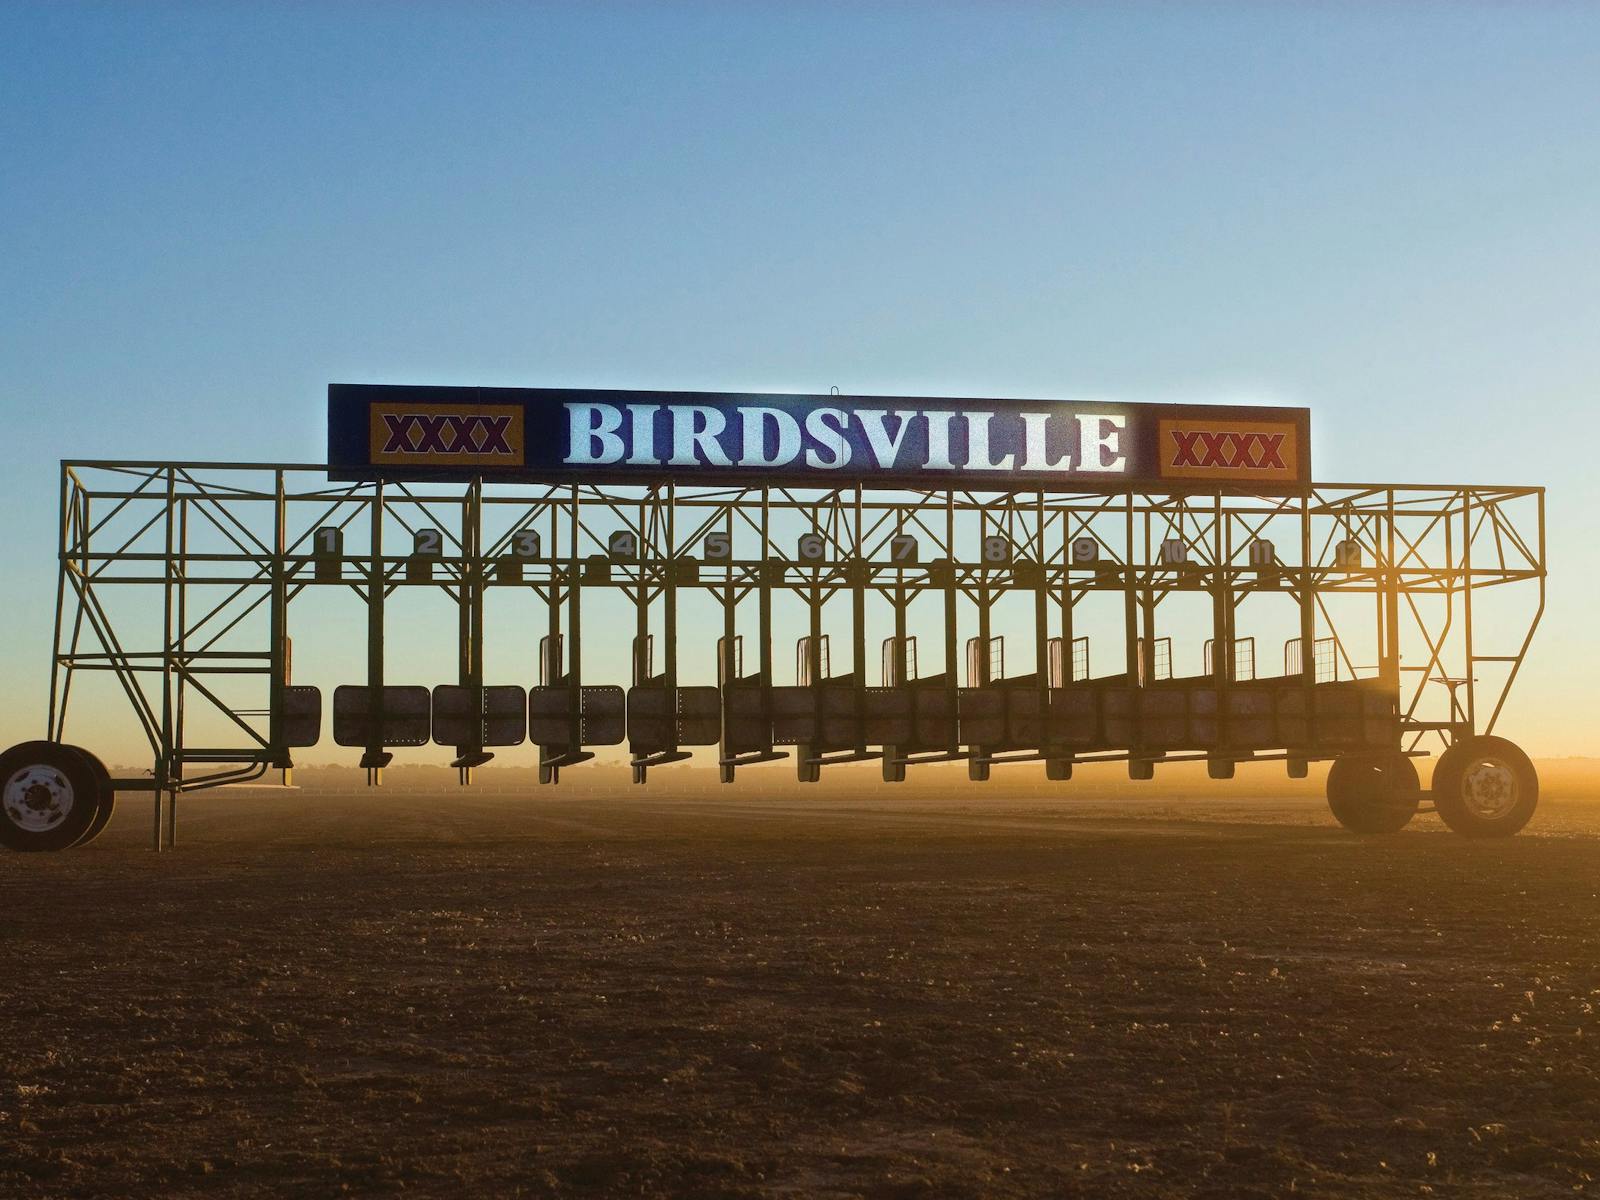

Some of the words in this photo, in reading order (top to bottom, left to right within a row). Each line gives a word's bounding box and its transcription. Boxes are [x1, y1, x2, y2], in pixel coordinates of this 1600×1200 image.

[381, 413, 513, 454] XXXX
[563, 402, 1127, 473] BIRDSVILLE
[1169, 430, 1287, 469] XXXX
[320, 529, 337, 552] 1
[417, 532, 440, 554] 2
[516, 532, 538, 556] 3
[612, 534, 635, 556] 4
[706, 534, 729, 557] 5
[801, 535, 824, 558] 6
[892, 537, 915, 560] 7
[985, 537, 1007, 561] 8
[1075, 538, 1097, 561] 9
[1164, 540, 1187, 562] 10
[1251, 540, 1272, 563] 11
[1337, 542, 1360, 565] 12
